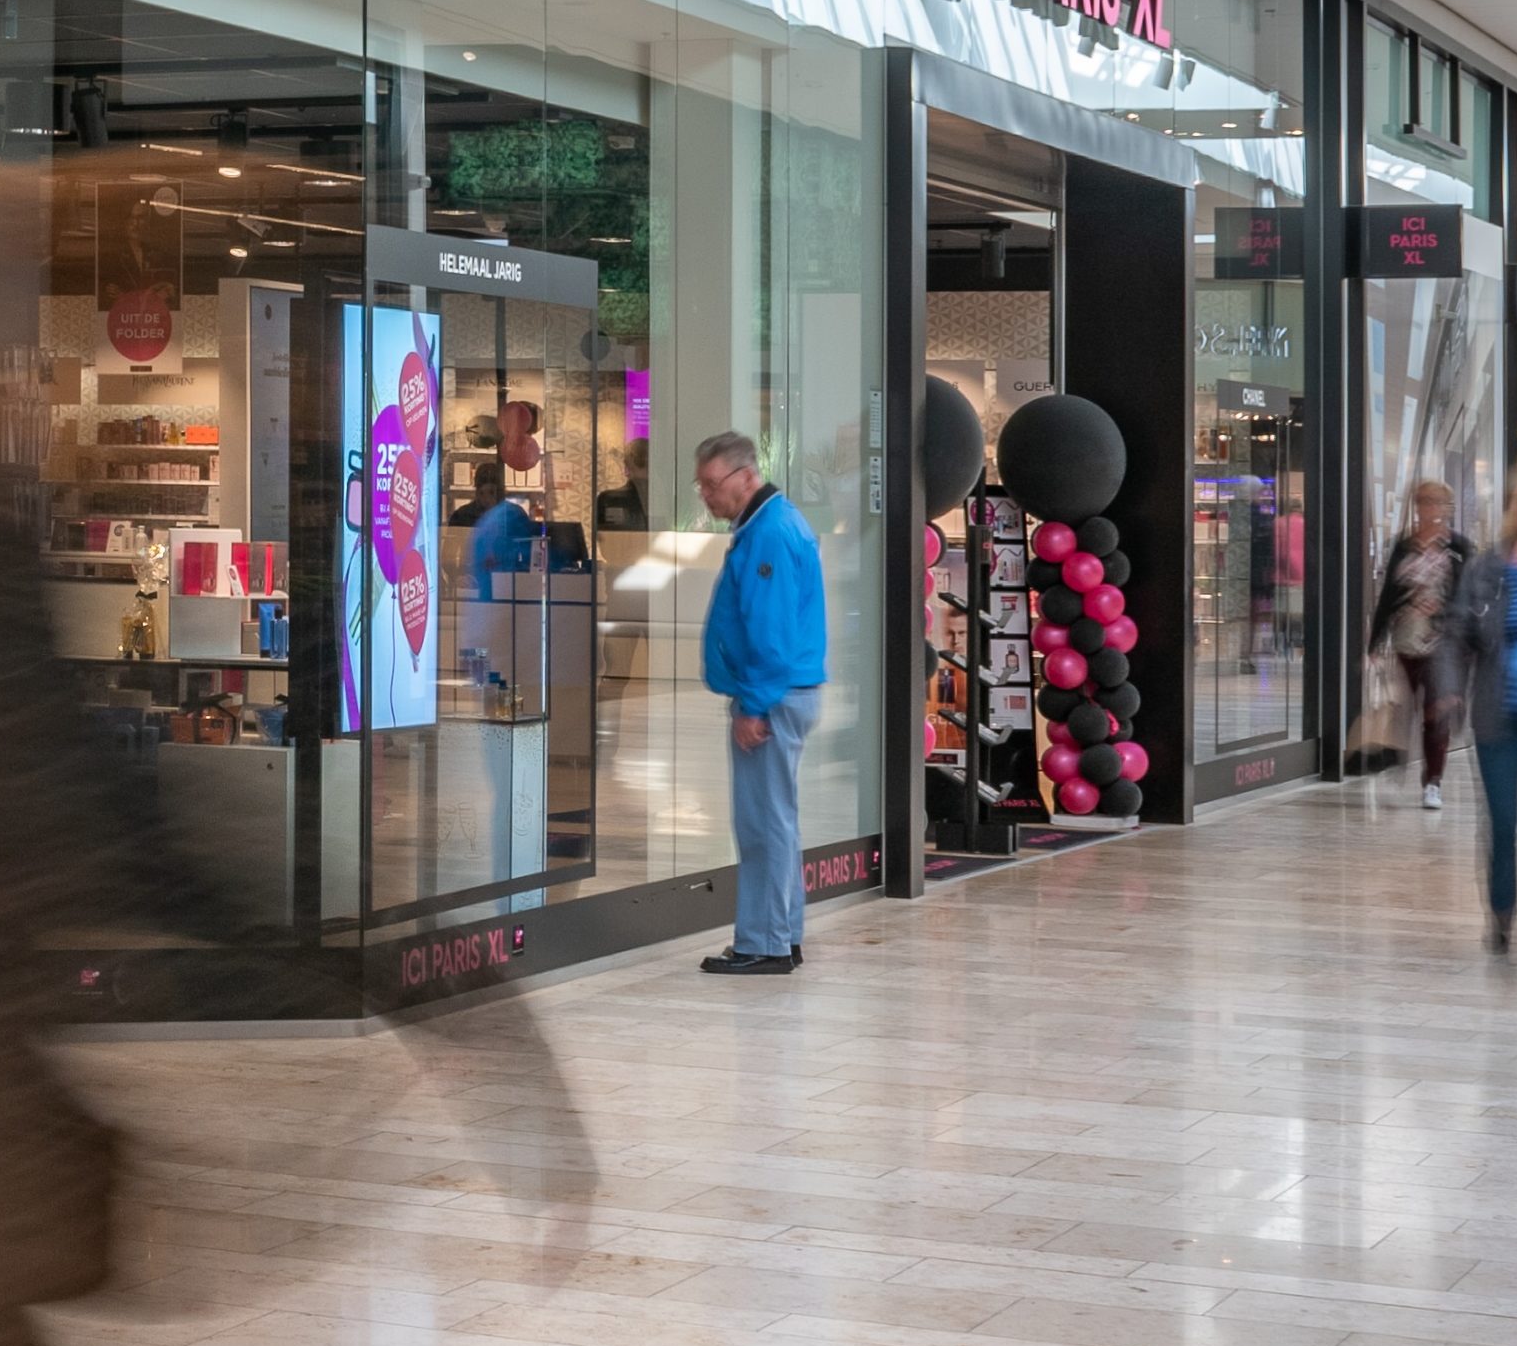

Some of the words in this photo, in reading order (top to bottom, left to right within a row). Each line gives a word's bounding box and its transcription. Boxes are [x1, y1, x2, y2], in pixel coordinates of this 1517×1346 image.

[1402, 217, 1426, 232] ICI
[1389, 234, 1438, 248] PARIS
[439, 252, 493, 279] HELEMAAL
[494, 260, 522, 283] JARIG
[1403, 252, 1425, 265] XL
[115, 328, 165, 339] FOLDER
[120, 313, 143, 324] UIT
[145, 313, 160, 324] DE
[401, 372, 425, 405] 25%
[394, 472, 418, 505] 25%
[400, 572, 425, 605] 25%
[819, 854, 849, 889] PARIS
[853, 850, 868, 880] XL
[402, 946, 427, 987] ICI
[432, 934, 481, 980] PARIS
[487, 928, 510, 967] XL
